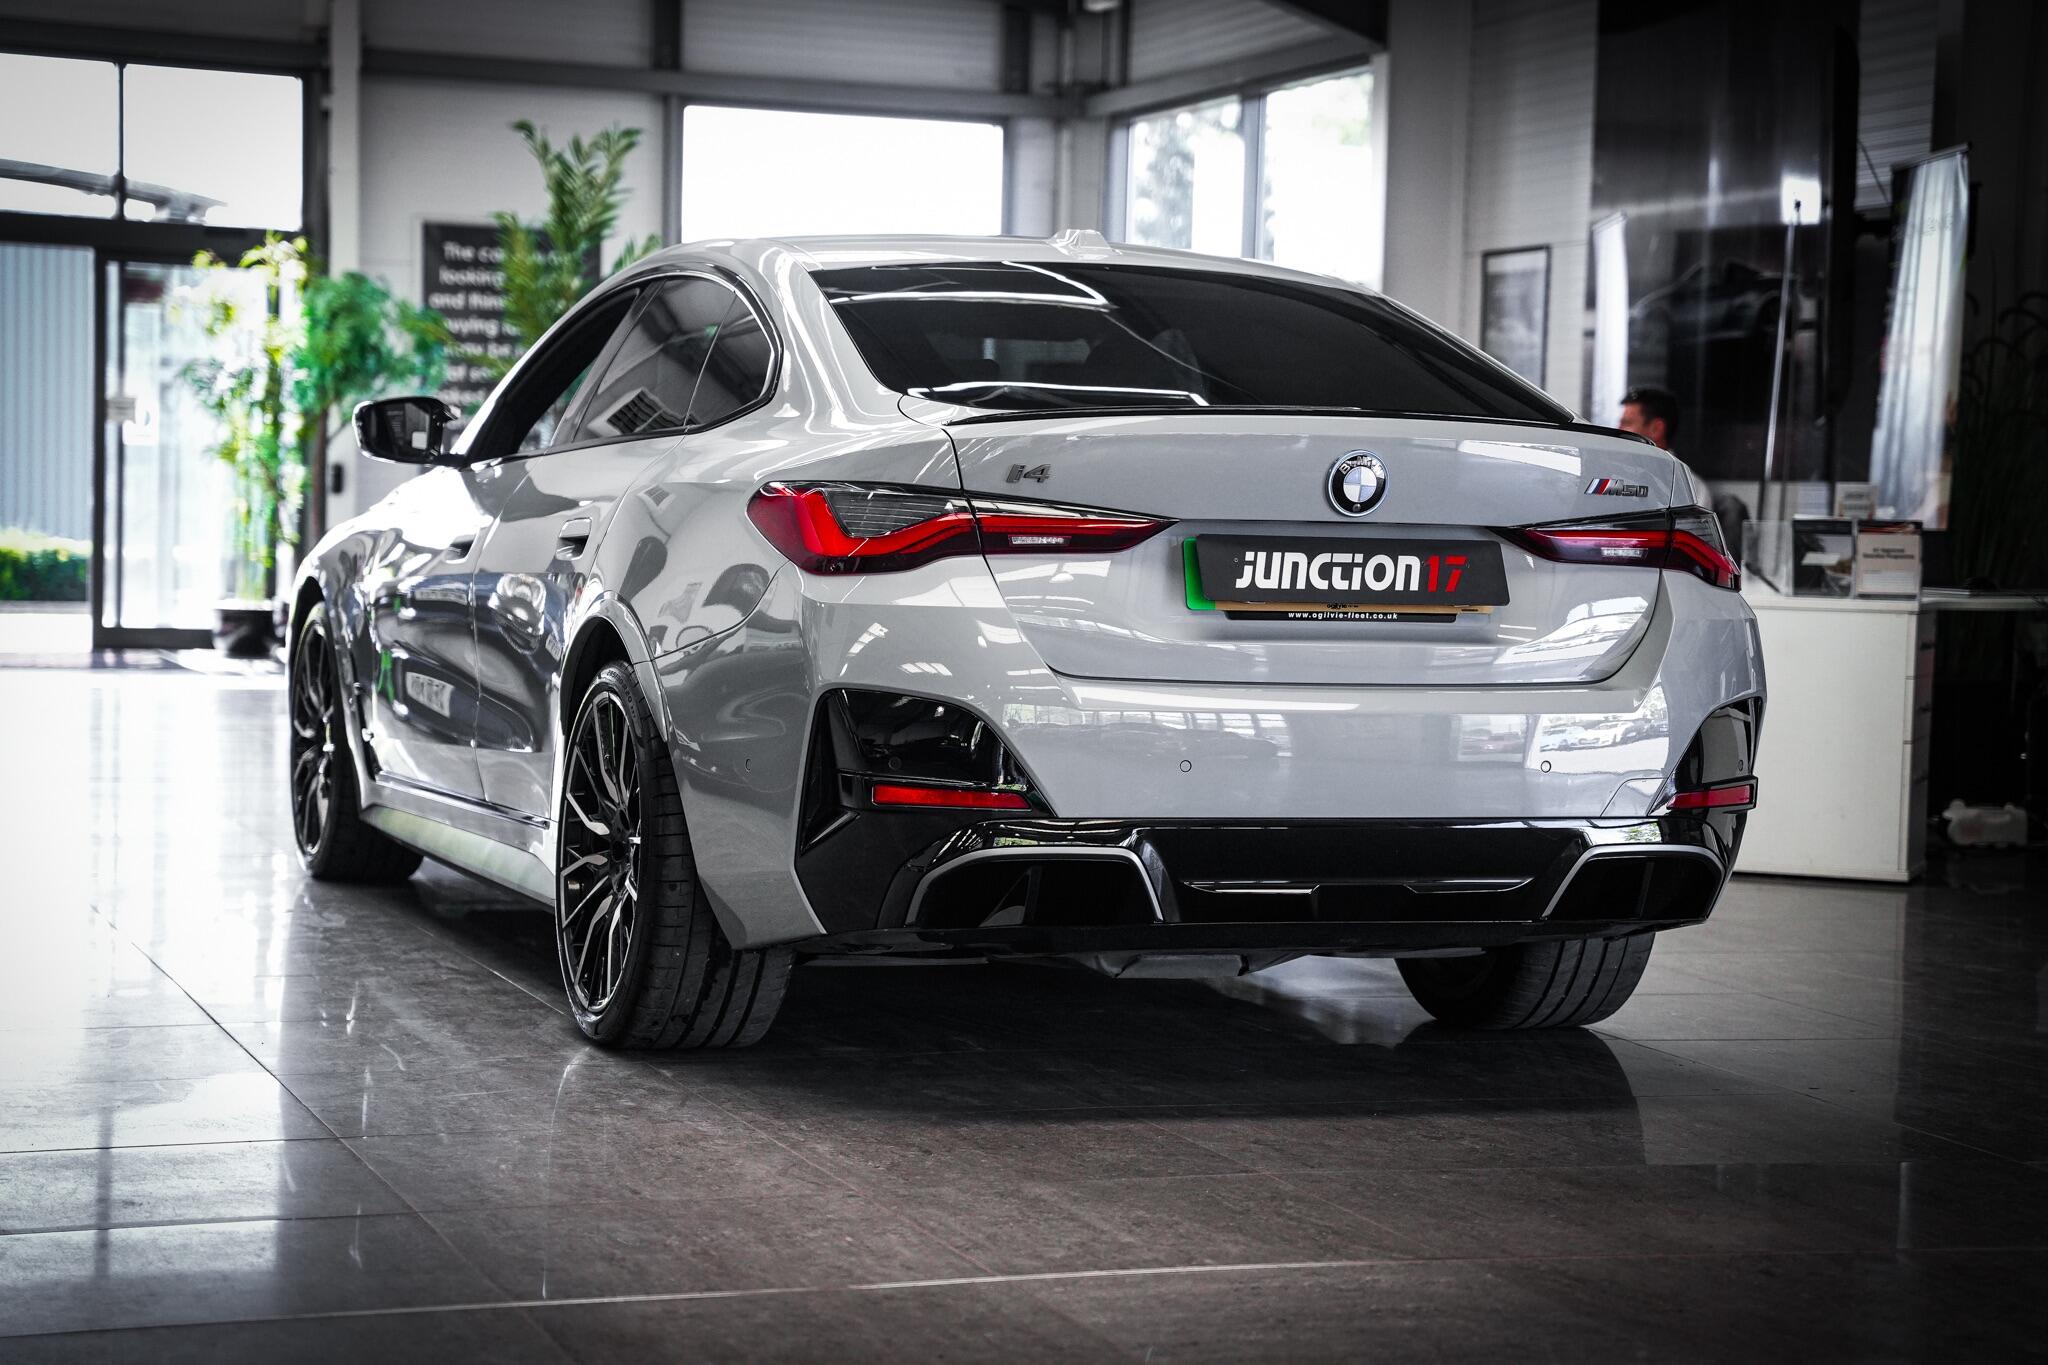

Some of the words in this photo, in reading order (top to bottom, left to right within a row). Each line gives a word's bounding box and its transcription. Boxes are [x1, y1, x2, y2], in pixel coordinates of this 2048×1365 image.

[443, 241, 474, 262] The
[429, 291, 466, 310] and
[445, 316, 499, 338] uying
[1006, 463, 1051, 483] i4
[1600, 478, 1648, 497] M50
[1288, 610, 1399, 620] www.ogilvie-fleet.co.uk
